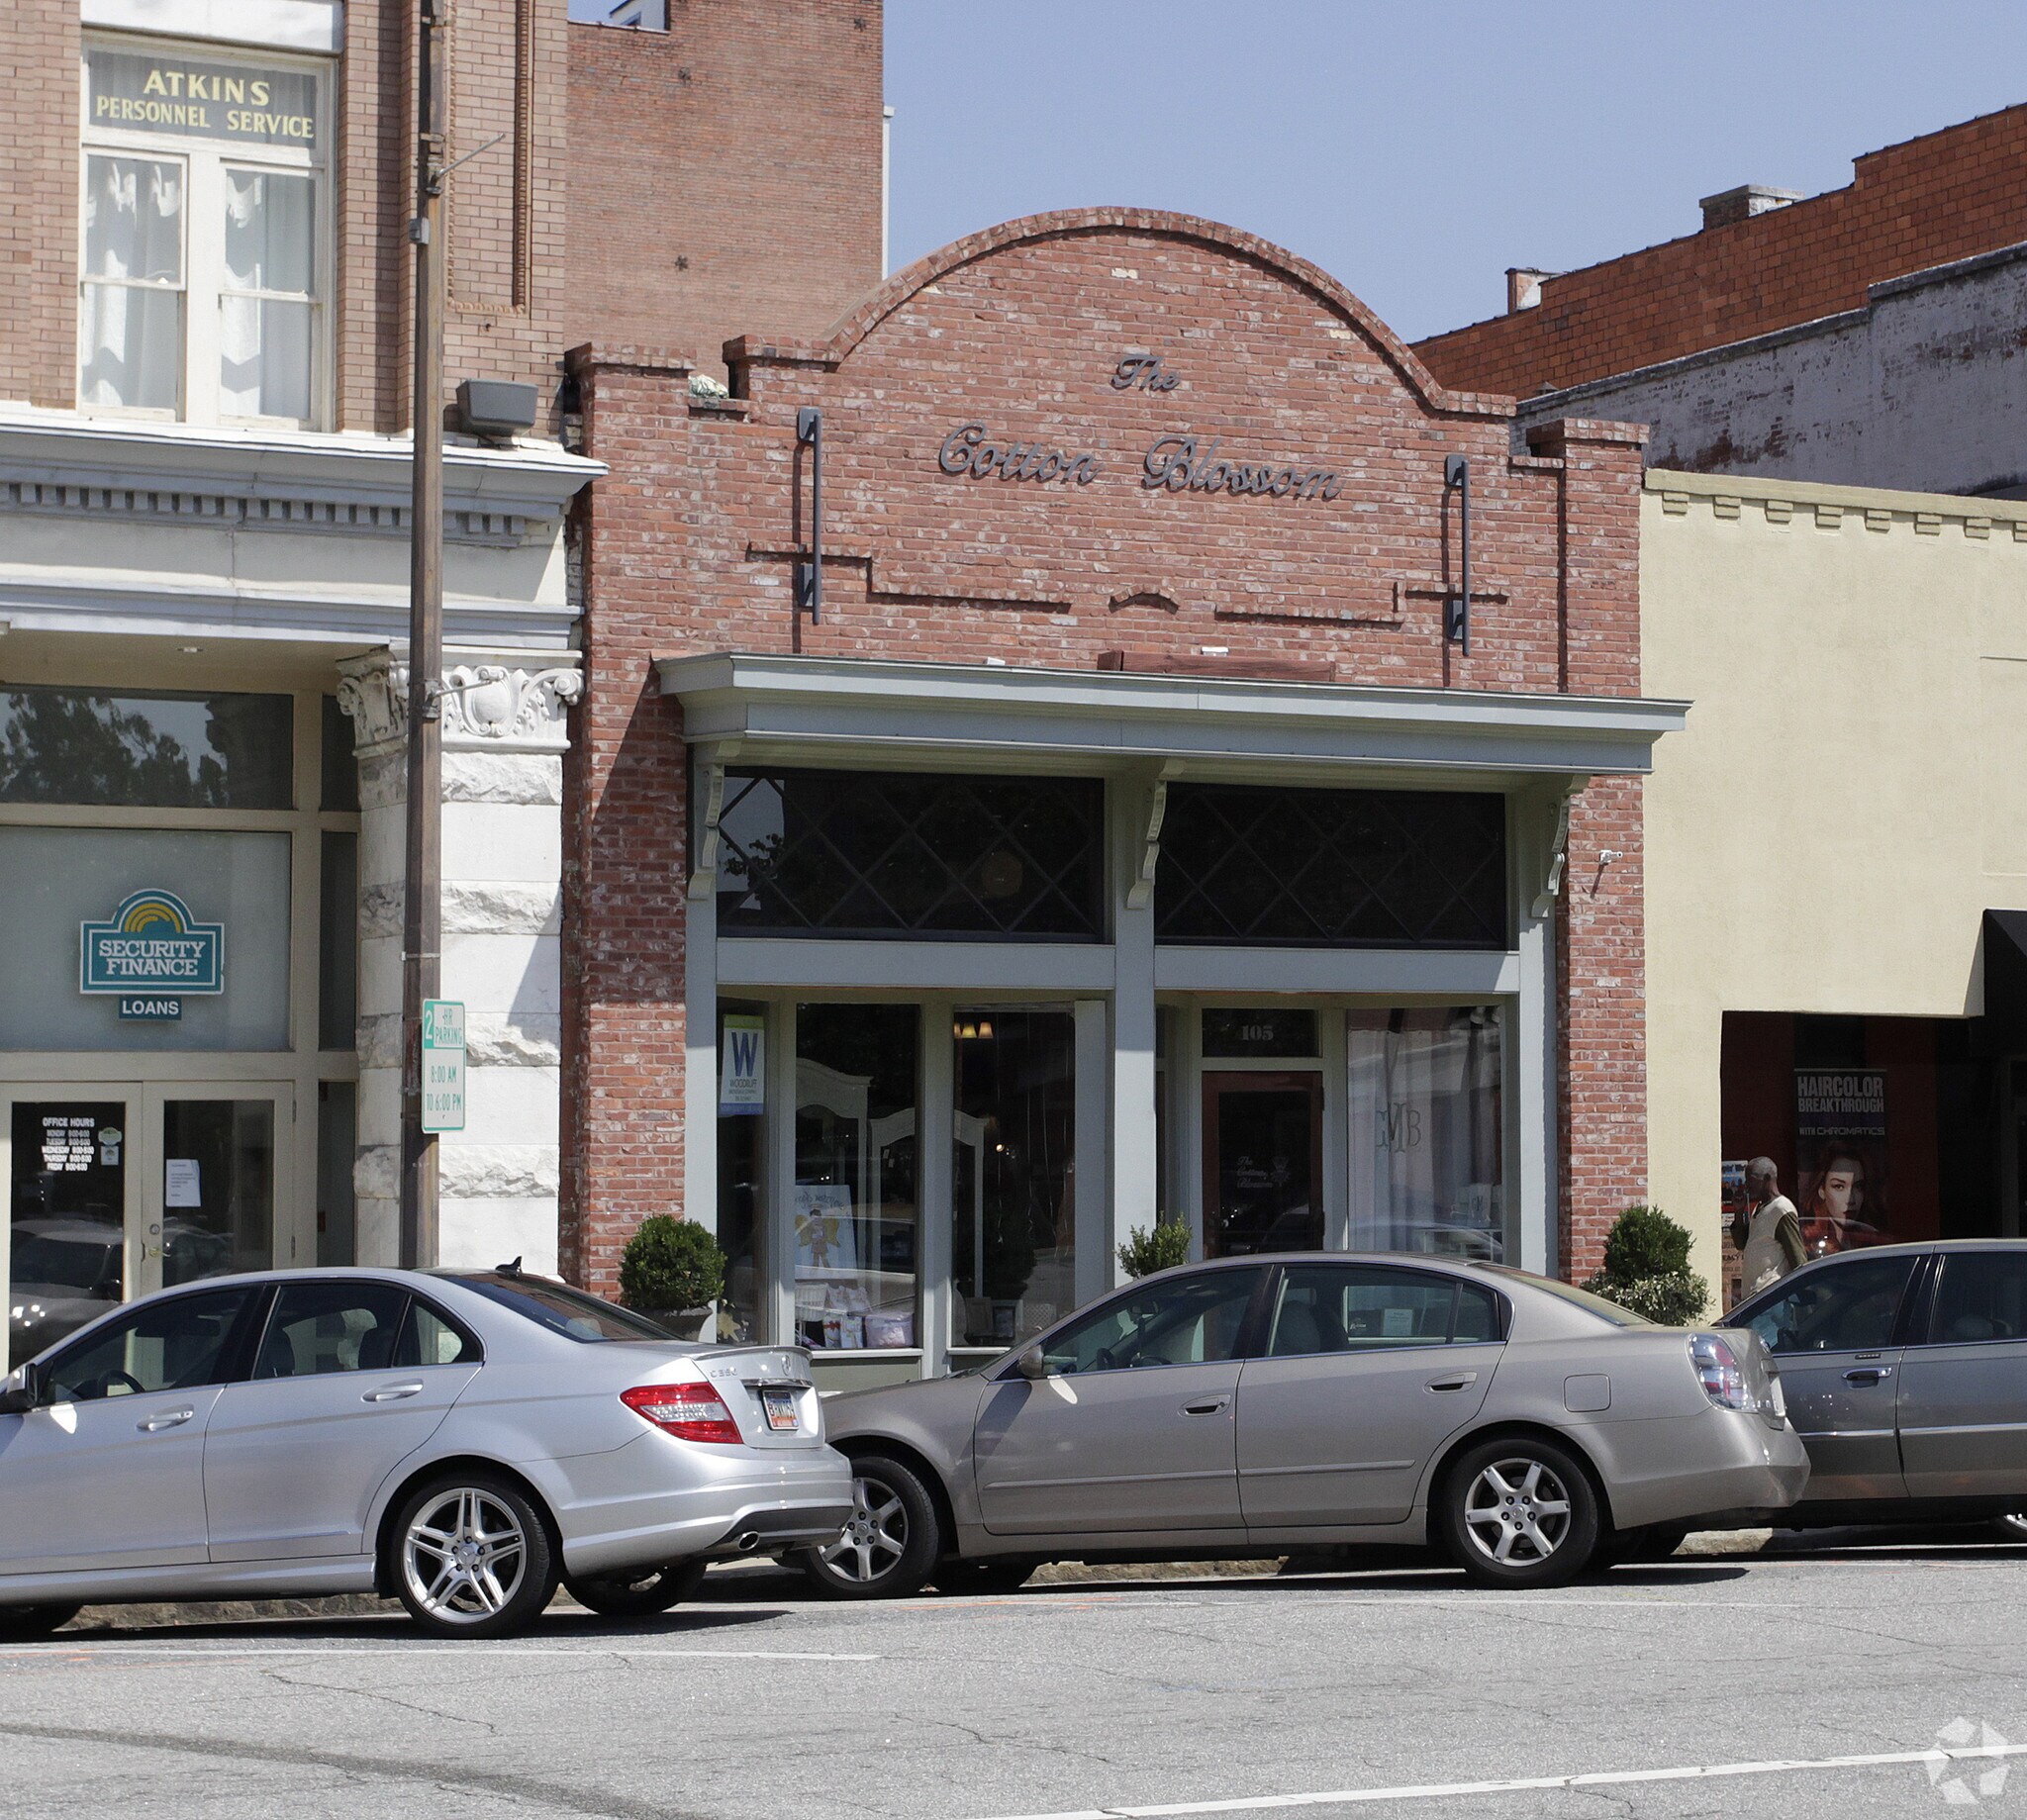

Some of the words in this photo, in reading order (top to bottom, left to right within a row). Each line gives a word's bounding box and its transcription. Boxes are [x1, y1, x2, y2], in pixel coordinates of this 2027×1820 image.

[144, 69, 270, 107] ATKINS
[96, 96, 211, 129] PERSONNEL
[227, 110, 314, 139] SERVICE
[1110, 353, 1181, 392] The
[939, 421, 1105, 486] Cotton
[1141, 435, 1345, 503] Blossom
[99, 939, 206, 958] SECURITY
[106, 958, 199, 976] FINANCE
[122, 1000, 179, 1015] LOANS
[425, 1009, 433, 1040] 2
[1242, 1024, 1274, 1041] 105
[435, 1026, 462, 1045] PARKING
[731, 1031, 758, 1077] W
[447, 1066, 457, 1084] AM
[1797, 1076, 1883, 1098] HAIRCOLOR
[452, 1094, 461, 1111] PM
[1798, 1098, 1884, 1113] BREAKTHROUGH
[43, 1117, 68, 1127] OFFICE
[70, 1117, 95, 1127] HOURS
[1817, 1126, 1885, 1136] CHROMATICS
